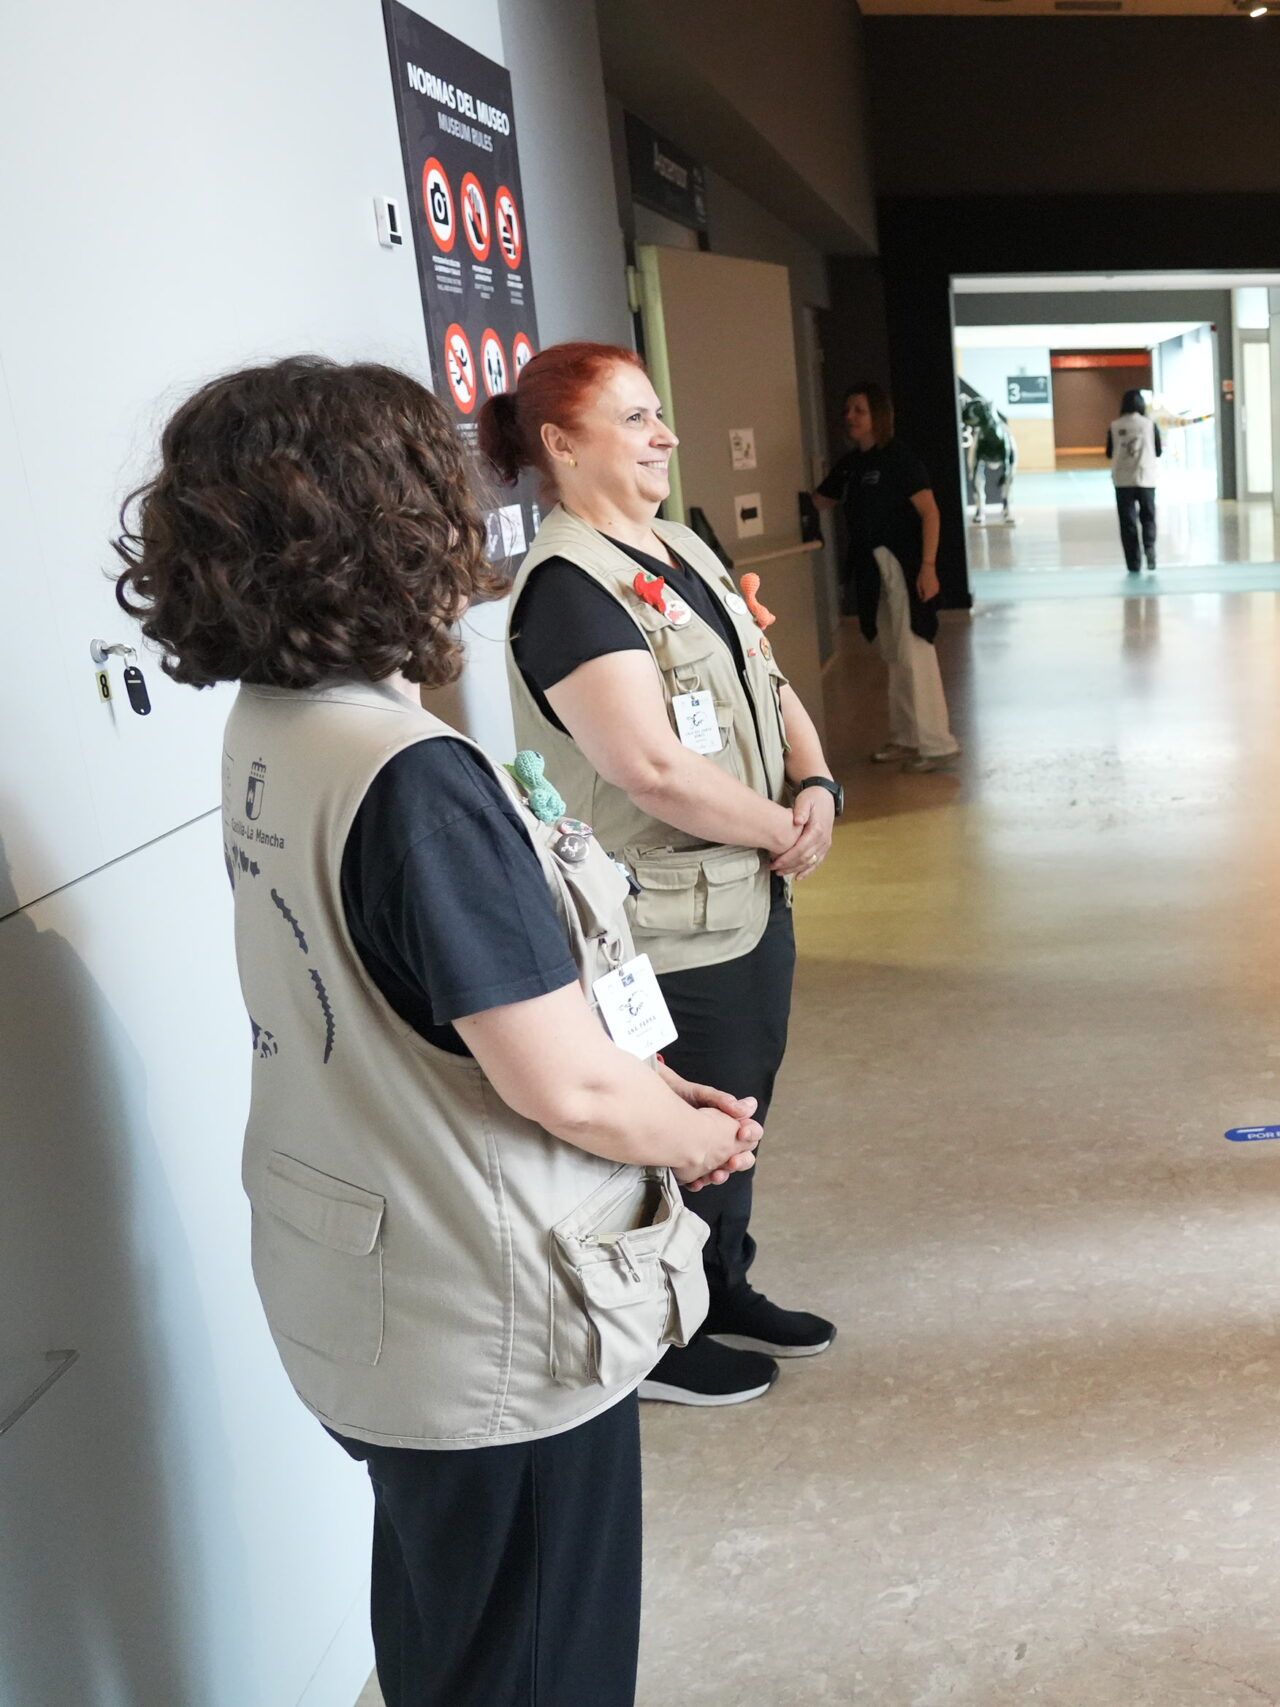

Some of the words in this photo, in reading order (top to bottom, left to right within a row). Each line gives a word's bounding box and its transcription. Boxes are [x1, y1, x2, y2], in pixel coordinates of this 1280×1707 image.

[407, 61, 456, 110] NORMAS
[456, 88, 477, 120] DEL
[476, 99, 510, 136] MUSEO
[438, 111, 472, 142] MUSEUM
[471, 127, 493, 152] RULES
[1008, 382, 1021, 402] 3
[255, 827, 285, 850] Mancha
[1247, 1132, 1275, 1140] POR
